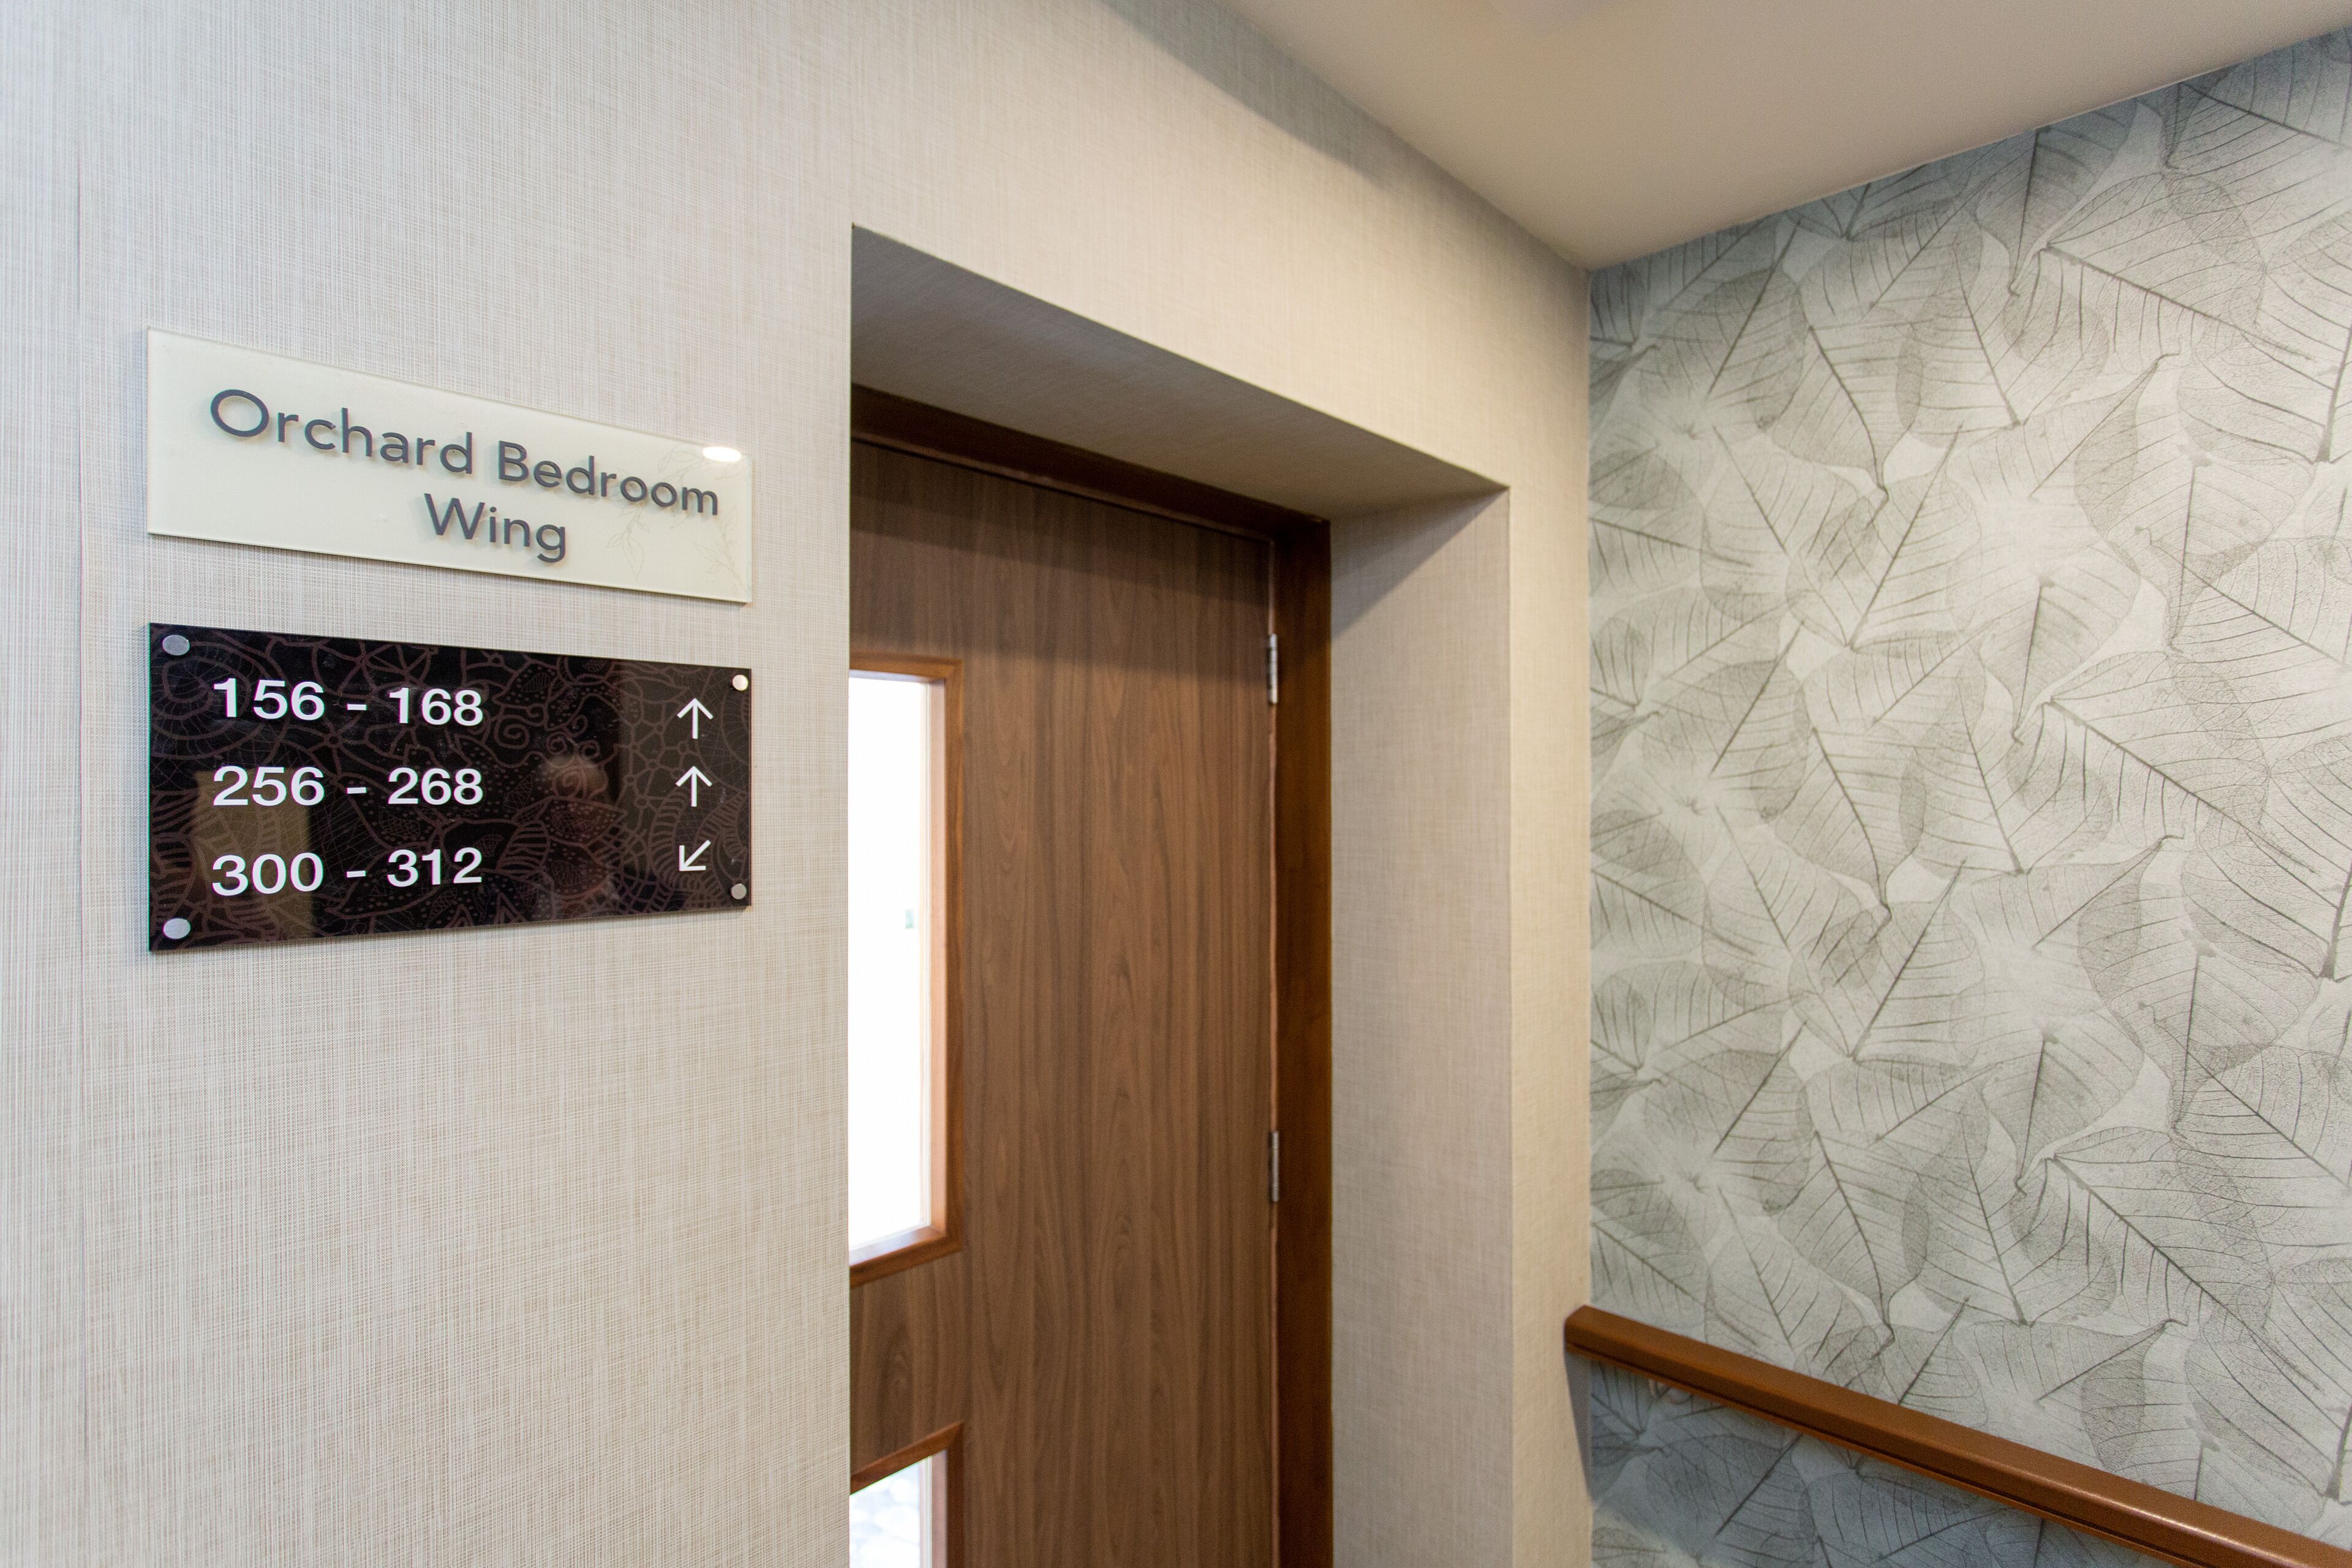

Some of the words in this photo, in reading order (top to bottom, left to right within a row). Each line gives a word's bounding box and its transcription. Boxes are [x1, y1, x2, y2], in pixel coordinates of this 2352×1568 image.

[209, 388, 473, 475] Orchard
[497, 440, 718, 516] Bedroom
[423, 492, 567, 564] Wing
[213, 677, 325, 721] 156
[388, 687, 483, 726] 168
[213, 765, 325, 807] 256
[387, 766, 483, 805] 268
[211, 851, 323, 897] 300
[386, 846, 483, 888] 312
